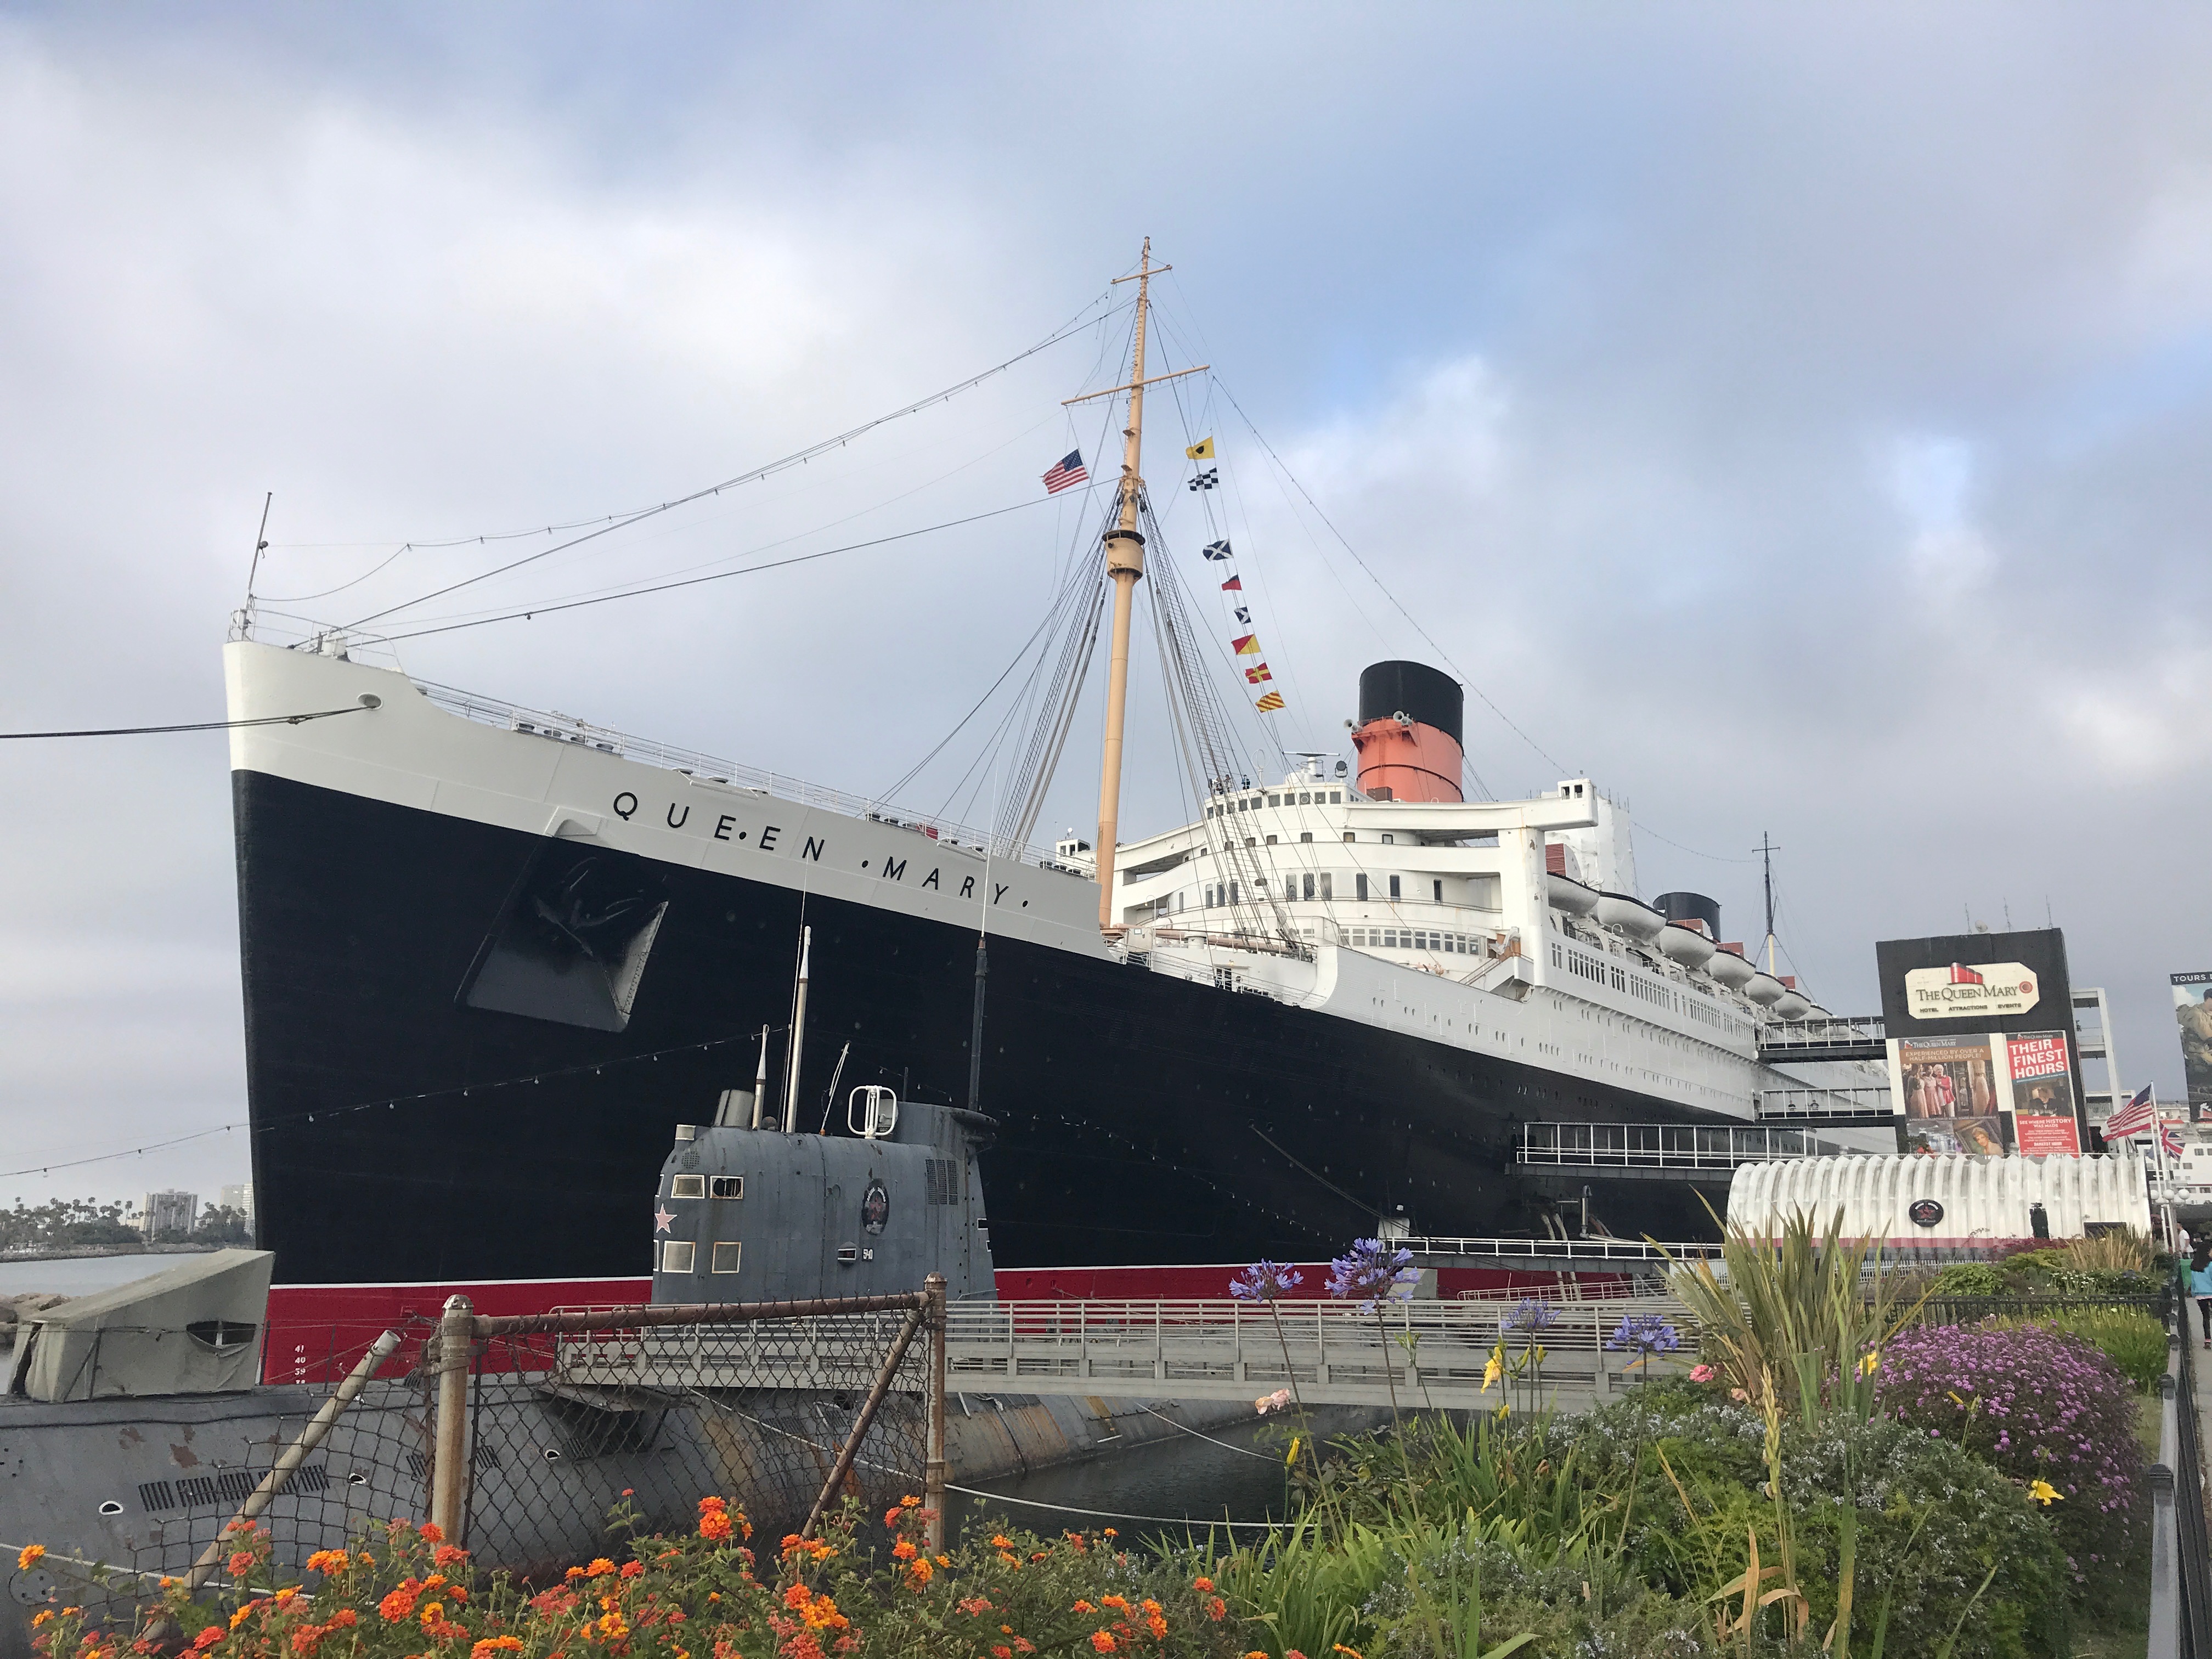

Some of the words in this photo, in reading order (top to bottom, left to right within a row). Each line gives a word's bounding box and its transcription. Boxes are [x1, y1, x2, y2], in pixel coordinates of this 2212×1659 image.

[613, 792, 825, 862] QUEEN
[882, 856, 1009, 905] MARY
[2173, 974, 2206, 982] TOURS
[1916, 989, 1940, 1001] THE
[1941, 987, 1982, 1002] QUEEN
[1983, 985, 2018, 997] MARY
[2010, 1039, 2052, 1055] THEIR
[2013, 1048, 2063, 1067] FINEST
[2015, 1061, 2064, 1079] HOURS
[295, 1345, 304, 1353] 41
